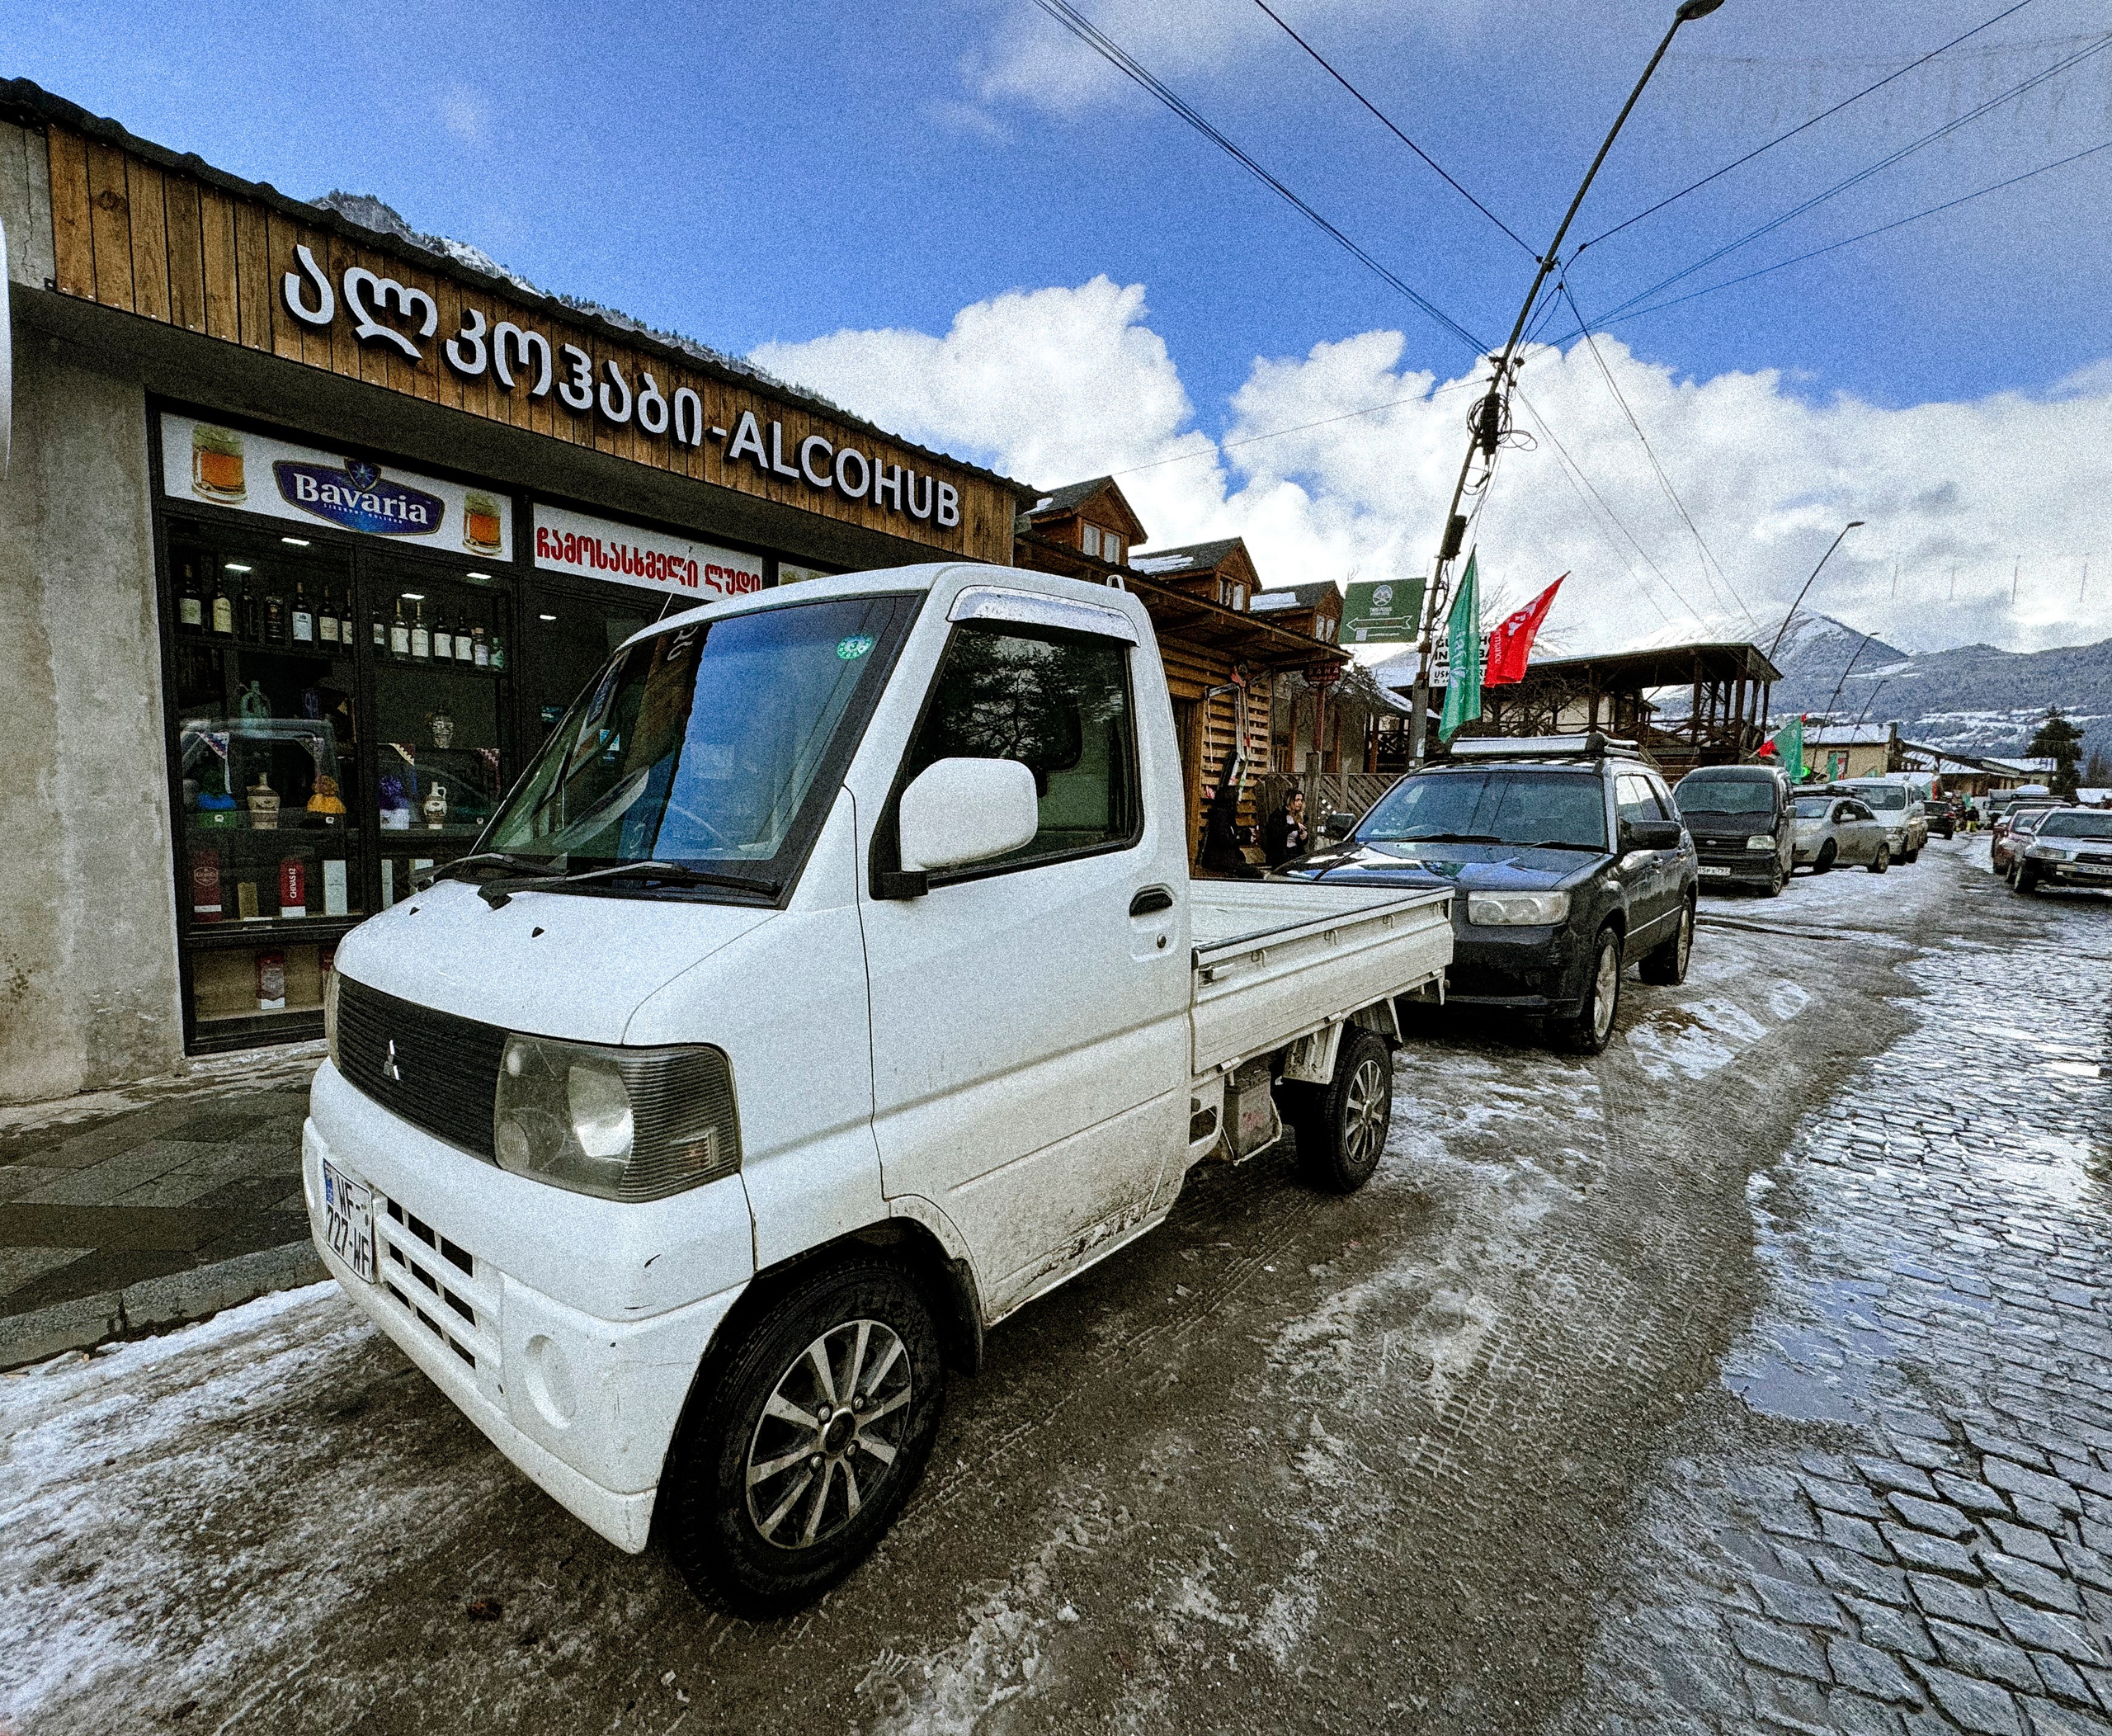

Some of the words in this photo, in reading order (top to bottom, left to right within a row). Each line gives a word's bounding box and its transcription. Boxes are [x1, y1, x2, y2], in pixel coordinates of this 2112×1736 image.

[294, 473, 427, 524] Bavaria
[536, 526, 698, 587] ჩამოსასხმელი
[705, 564, 761, 595] ლუდი
[289, 875, 297, 899] CHIVAS
[327, 1205, 370, 1276] 727-WF
